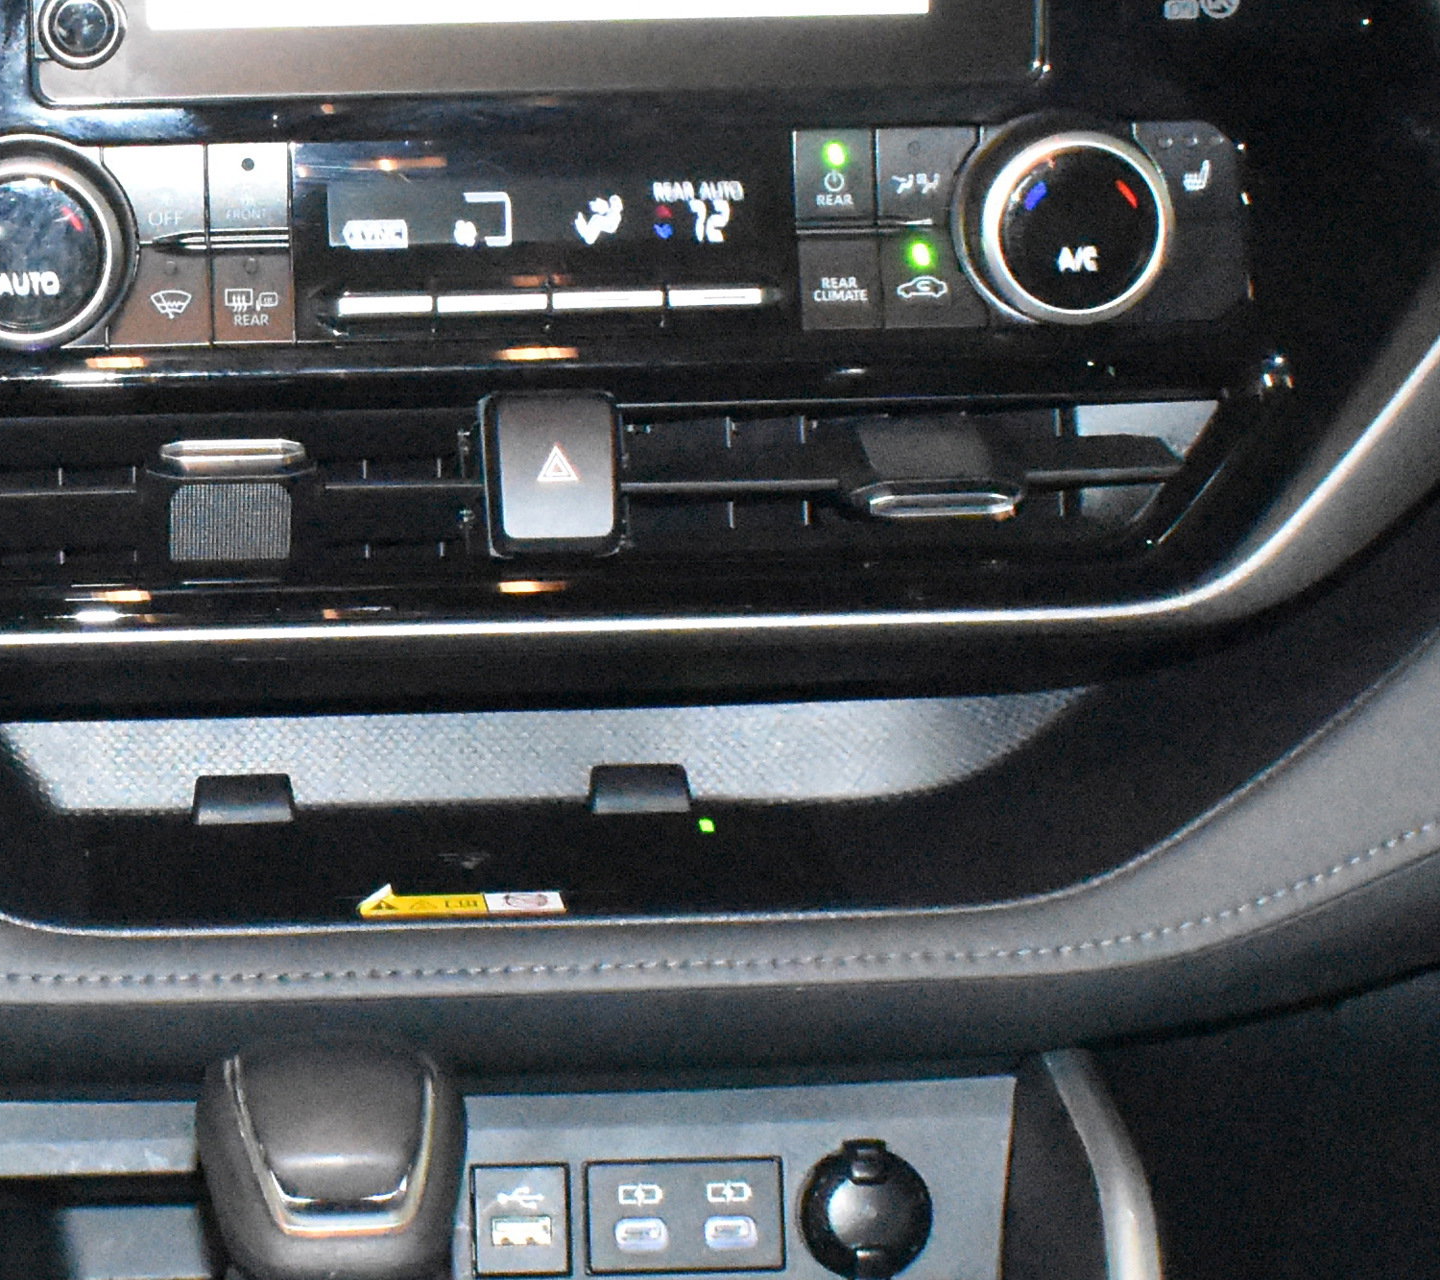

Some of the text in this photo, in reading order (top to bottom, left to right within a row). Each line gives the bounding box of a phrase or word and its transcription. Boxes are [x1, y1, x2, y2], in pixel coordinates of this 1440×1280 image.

[816, 193, 853, 206] REAR
[147, 209, 183, 226] OFF
[225, 208, 267, 220] FRONT
[689, 199, 730, 243] 72
[1057, 246, 1099, 272] A/C
[821, 276, 858, 290] REAR
[813, 289, 869, 303] CLIMATE
[233, 314, 269, 327] REAR
